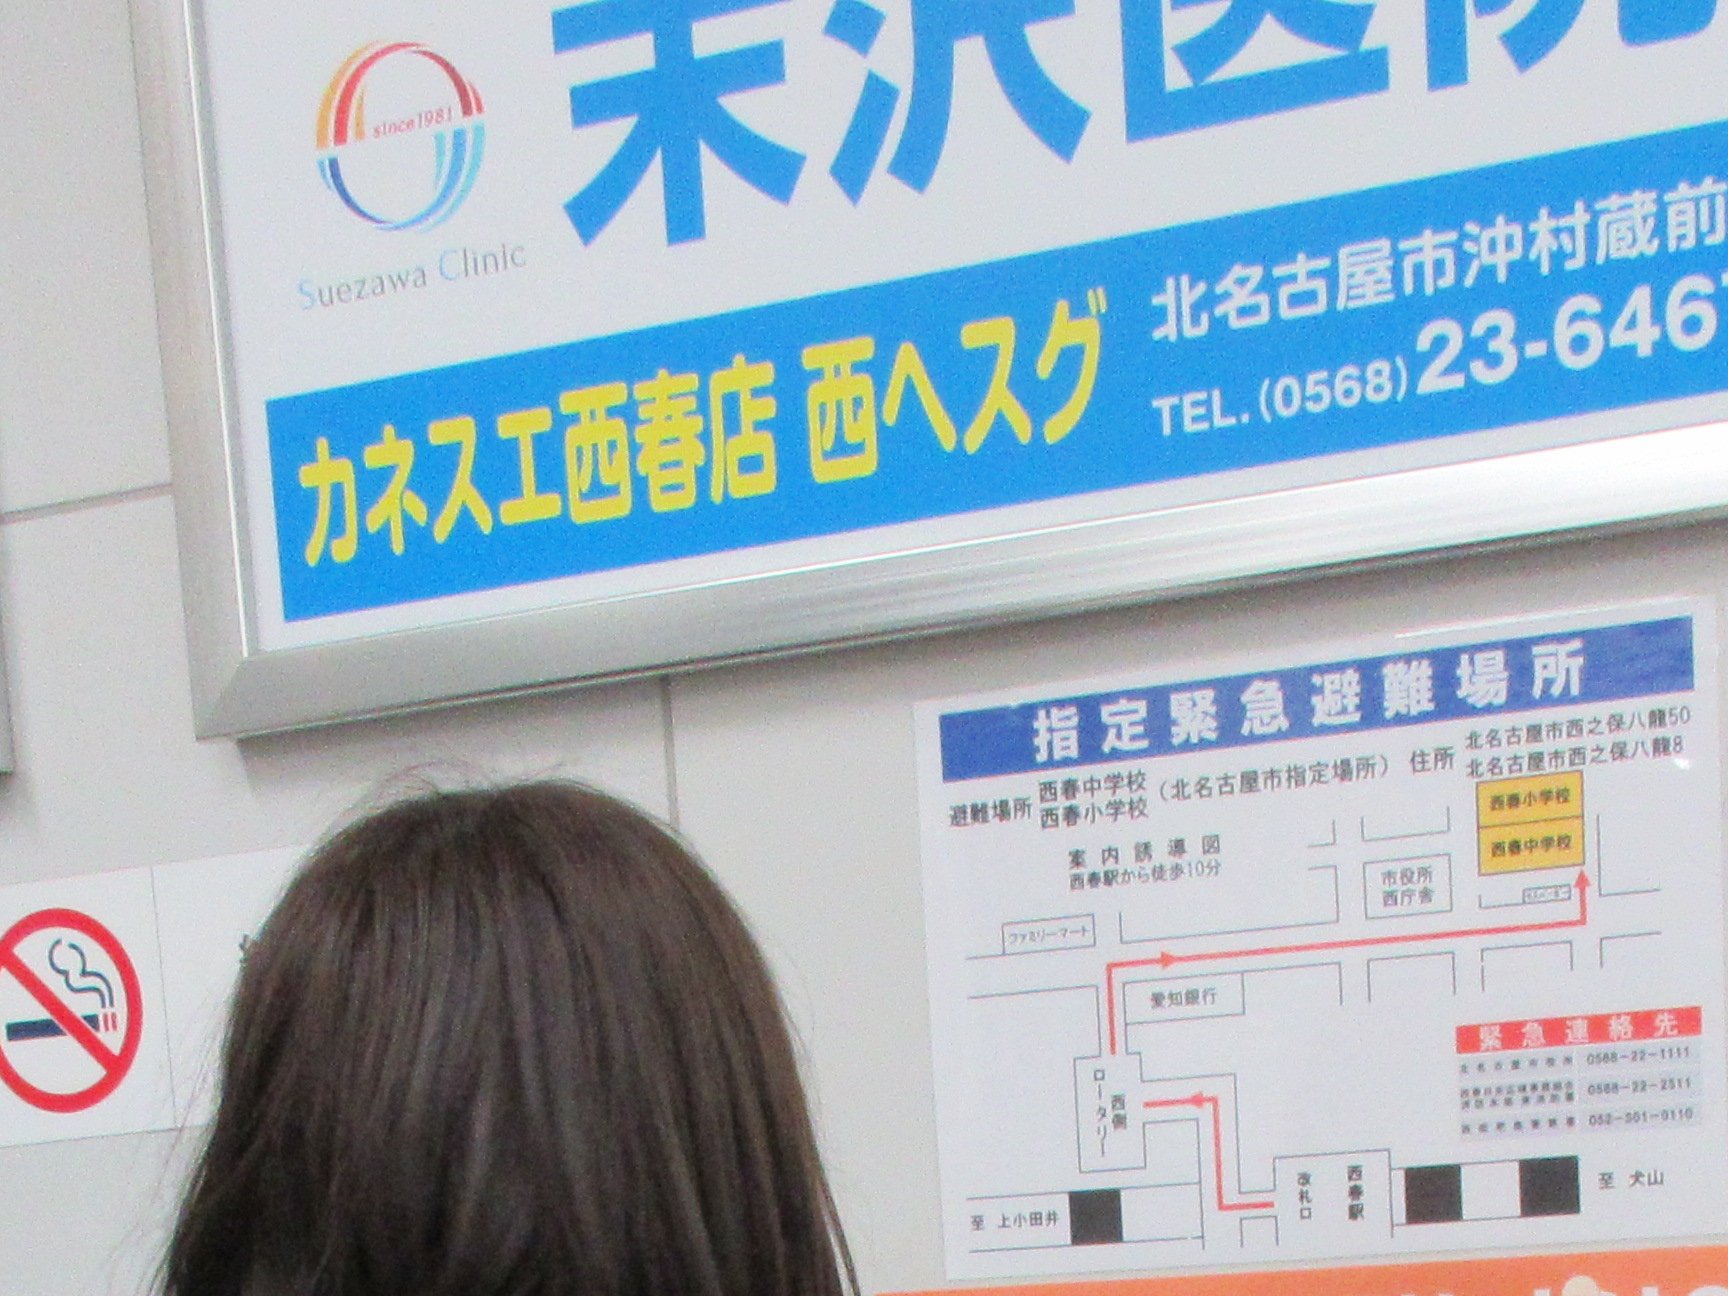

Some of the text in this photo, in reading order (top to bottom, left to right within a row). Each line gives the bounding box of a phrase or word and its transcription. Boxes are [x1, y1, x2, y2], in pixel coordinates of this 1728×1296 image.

[297, 241, 528, 312] Suezawa Clinic
[297, 353, 779, 569] カネスエ西春店
[1033, 639, 1586, 764] 指定緊急避難場所
[1410, 745, 1455, 774] 住所
[1038, 768, 1148, 804] 西春中学校
[1489, 786, 1571, 812] 西春小学校
[948, 796, 1033, 828] 避難場所
[1039, 795, 1149, 831] 西春小学校
[1490, 832, 1572, 859] 西春中学校
[1069, 857, 1223, 891] 西春駅から徒歩10分
[1380, 865, 1433, 887] 市役所
[1150, 987, 1217, 1010] 愛知銀行
[1629, 1169, 1665, 1188] 犬山
[996, 1208, 1060, 1230] 上小田井
